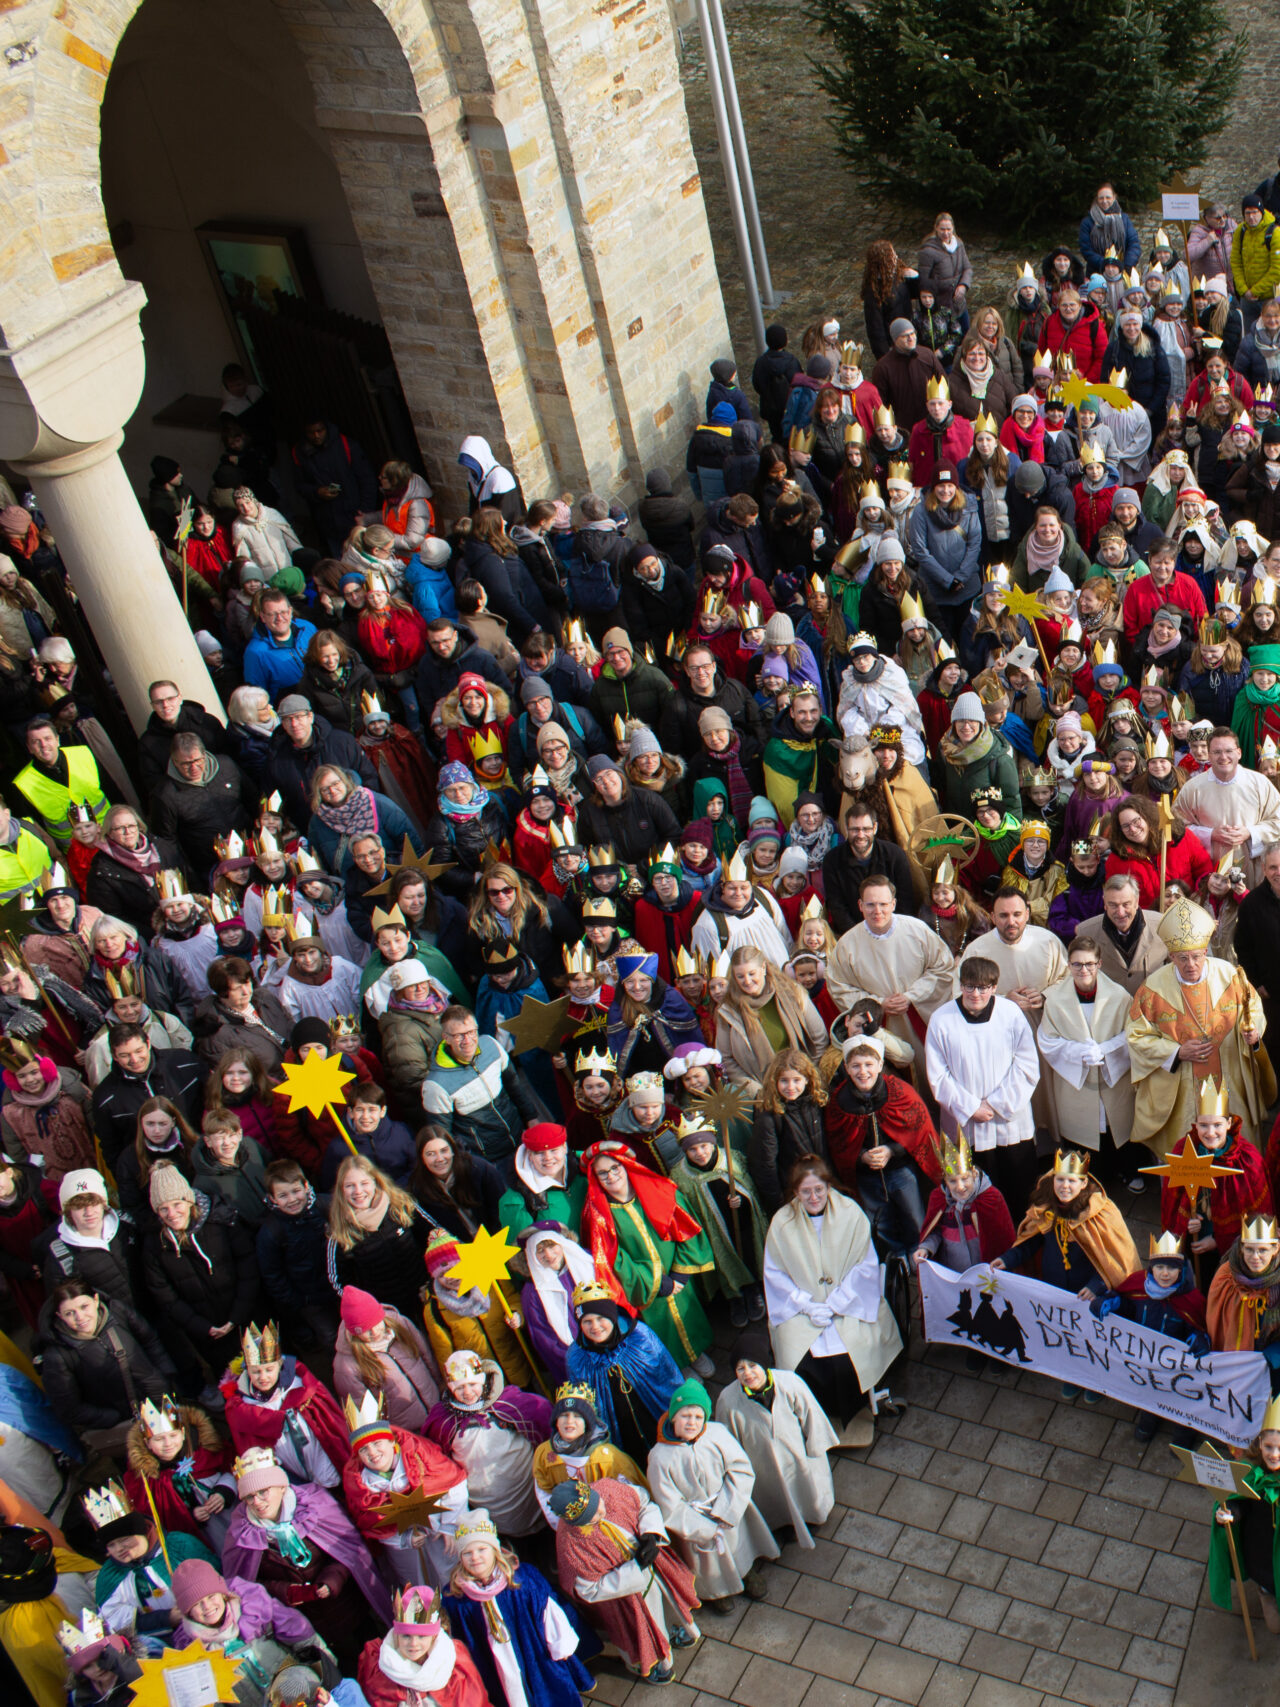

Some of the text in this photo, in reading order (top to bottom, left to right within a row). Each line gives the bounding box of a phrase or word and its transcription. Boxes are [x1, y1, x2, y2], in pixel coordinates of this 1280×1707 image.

[1029, 1299, 1213, 1376] WIR BRINGEN
[1036, 1320, 1253, 1423] DEN SEGEN
[1157, 1401, 1252, 1446] www.sternsinger.d
